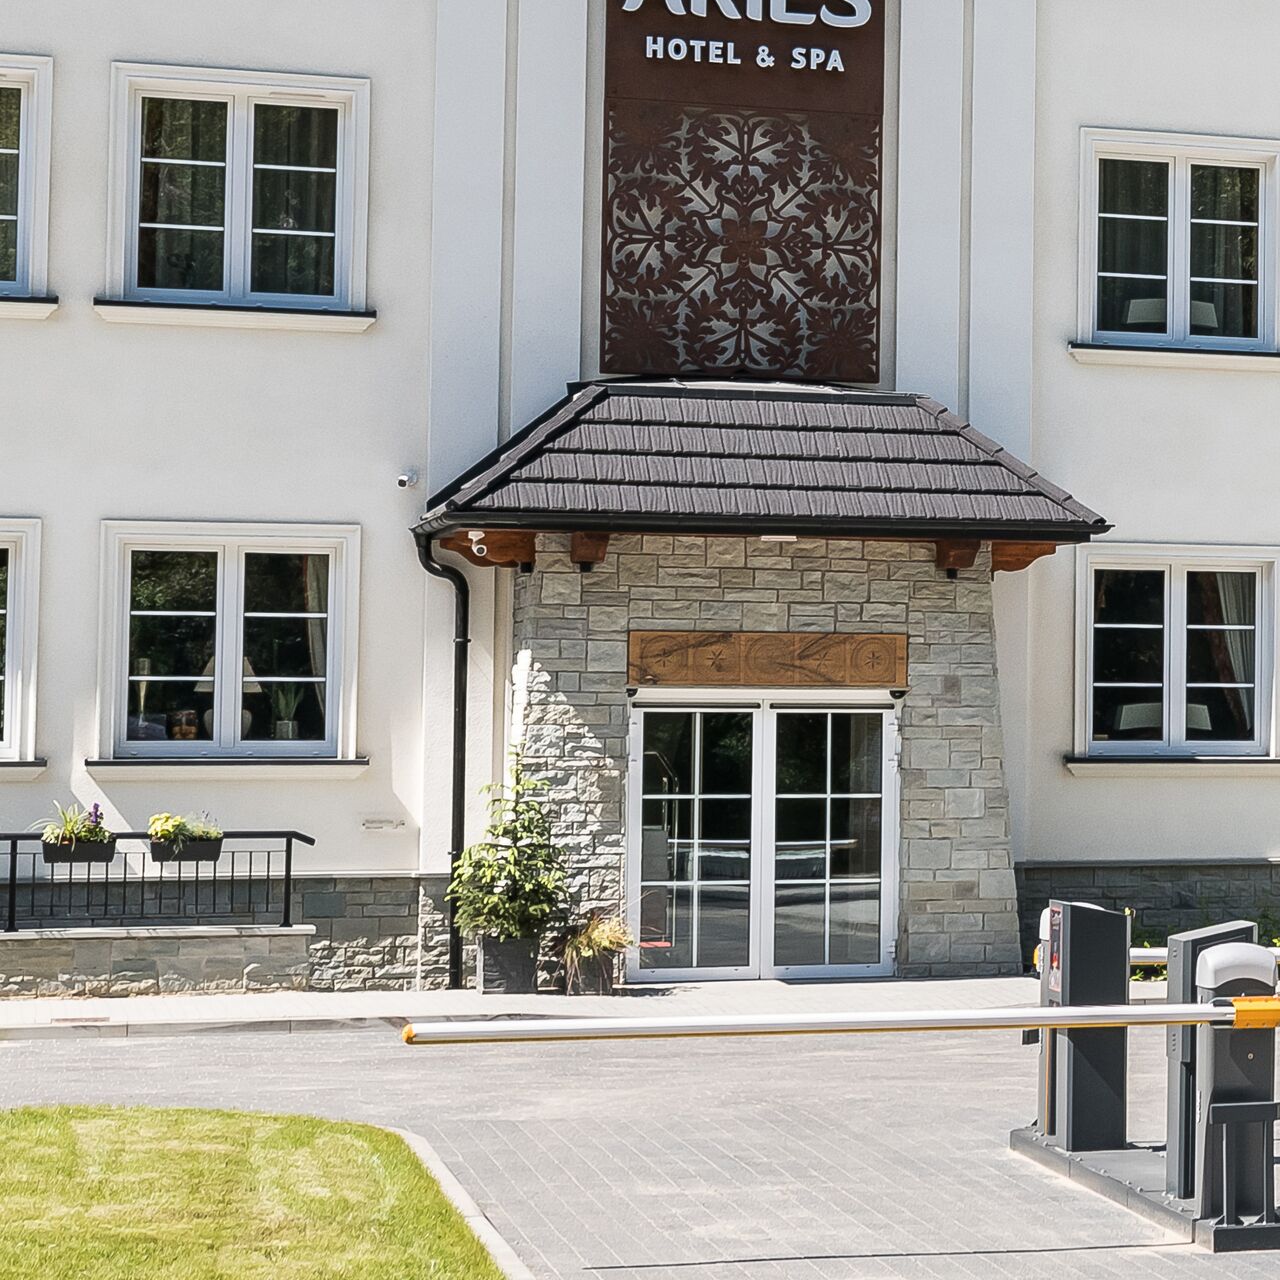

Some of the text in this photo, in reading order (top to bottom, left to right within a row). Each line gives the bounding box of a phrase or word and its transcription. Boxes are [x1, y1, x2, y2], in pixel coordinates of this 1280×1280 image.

[646, 36, 845, 72] HOTEL & SPA
